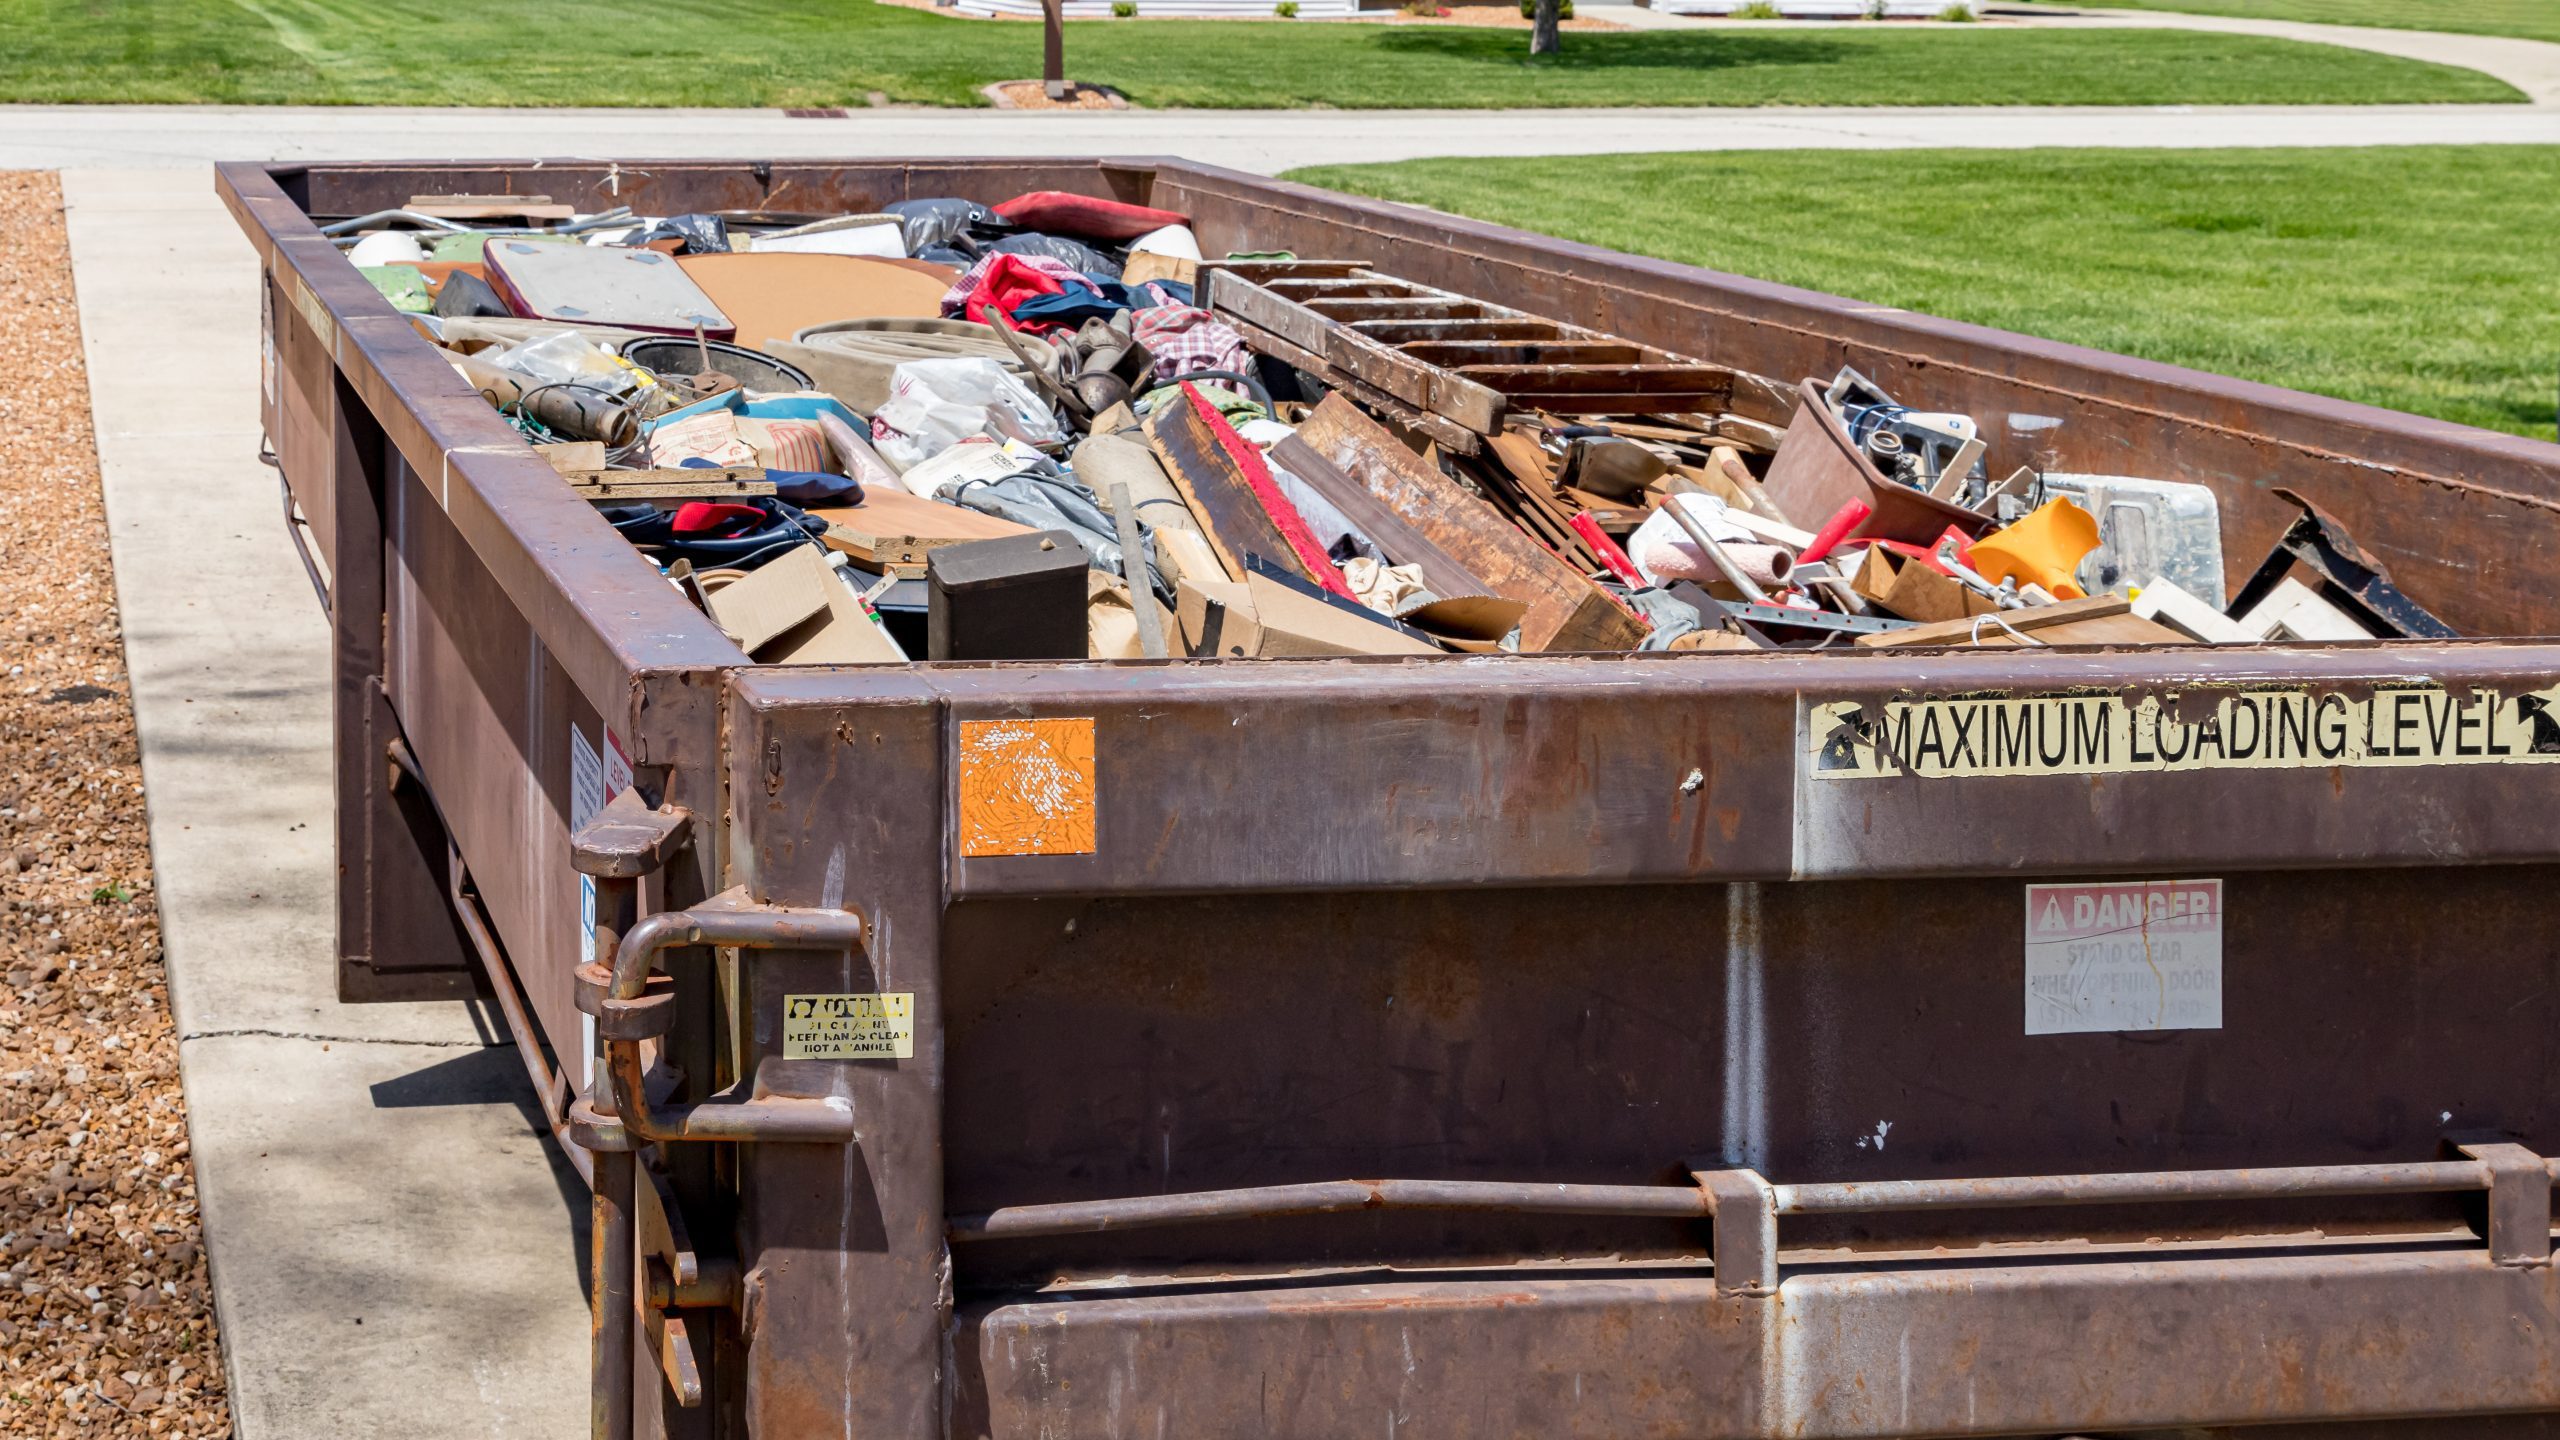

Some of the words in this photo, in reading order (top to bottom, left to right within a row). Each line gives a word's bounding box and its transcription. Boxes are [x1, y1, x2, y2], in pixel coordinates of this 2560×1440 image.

[1875, 702, 2110, 769] MAXIMUM
[2130, 696, 2347, 764] LOADING
[2367, 694, 2511, 757] LEVEL
[2073, 891, 2210, 929] DANGER
[2127, 940, 2182, 962] CLEAR
[2087, 972, 2163, 994] OPENIN
[2169, 970, 2216, 992] DOOR
[833, 1044, 840, 1052] A
[845, 1043, 893, 1052] ANDLE
